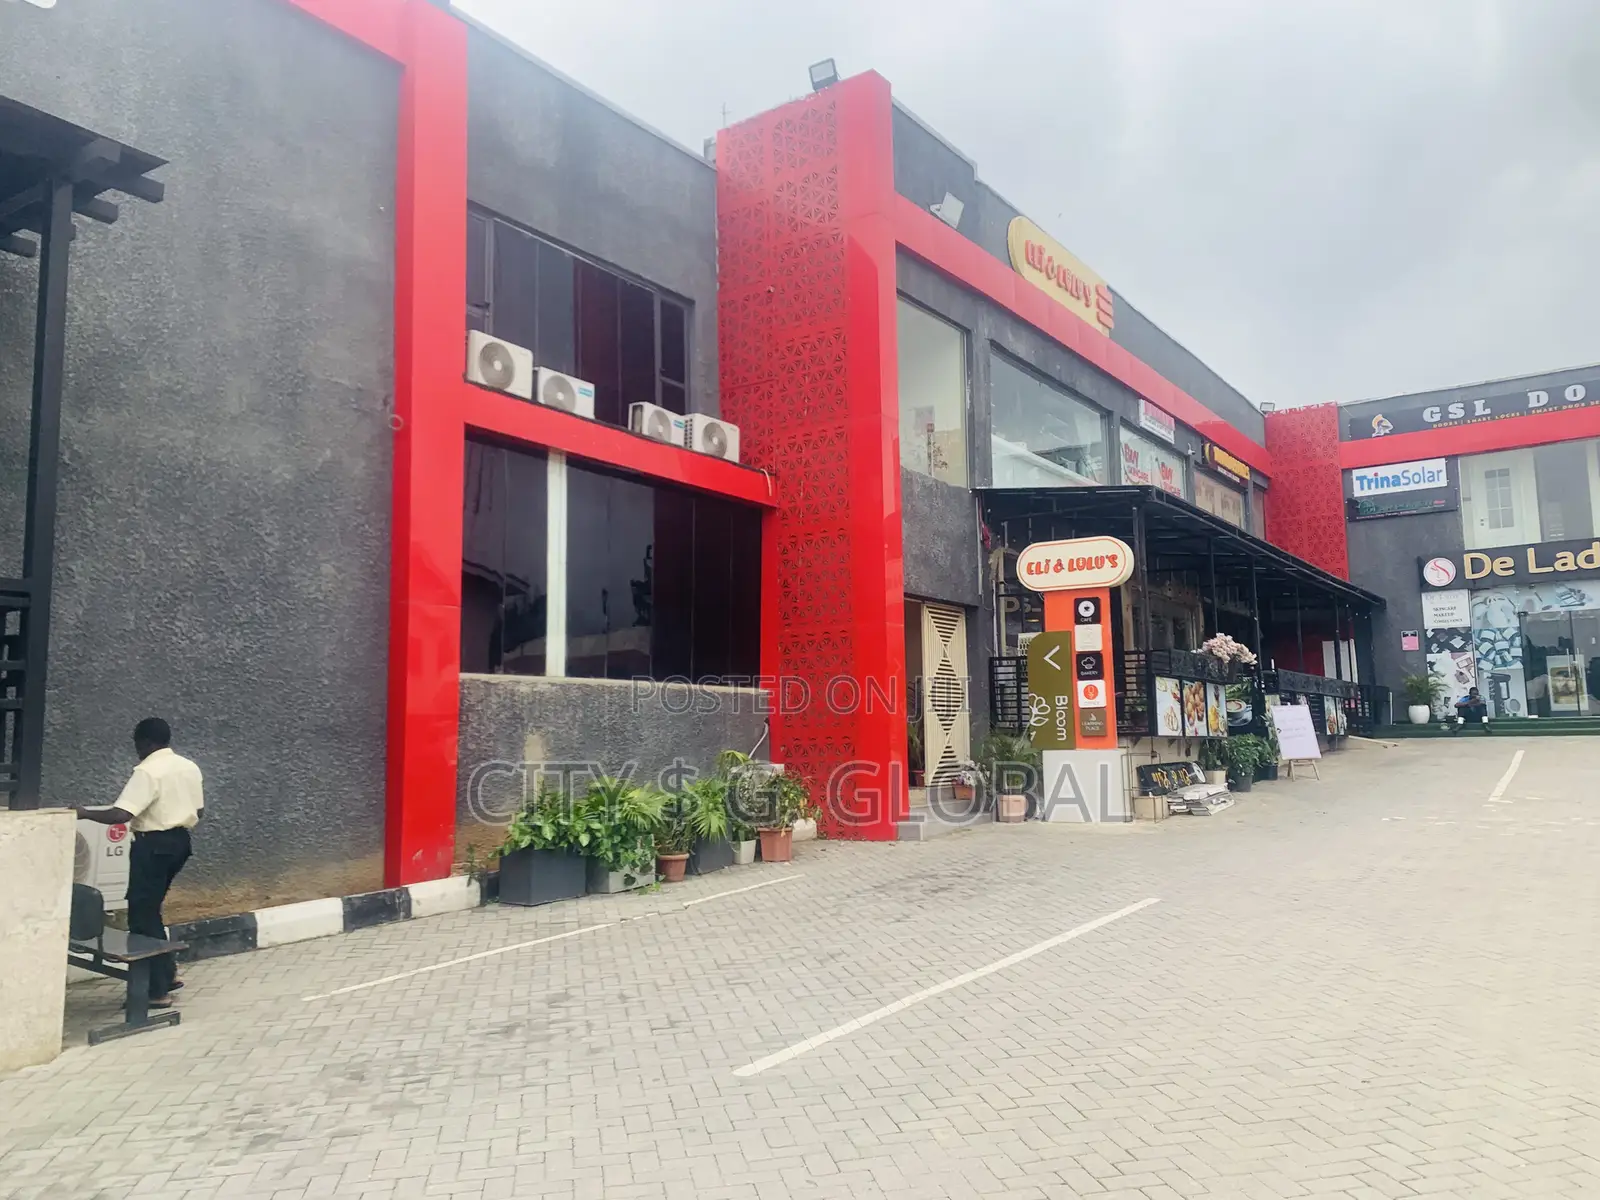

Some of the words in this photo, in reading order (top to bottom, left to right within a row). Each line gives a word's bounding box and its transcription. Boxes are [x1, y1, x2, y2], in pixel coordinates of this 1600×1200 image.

[1422, 399, 1491, 423] GSL
[1355, 466, 1443, 491] TrinaSolar
[1026, 558, 1051, 576] ELI
[1052, 559, 1065, 573] &
[1067, 553, 1119, 573] LULU'S
[1463, 552, 1515, 579] De
[1527, 541, 1600, 573] Lad
[1055, 695, 1069, 741] Bloom
[106, 846, 123, 857] LG
